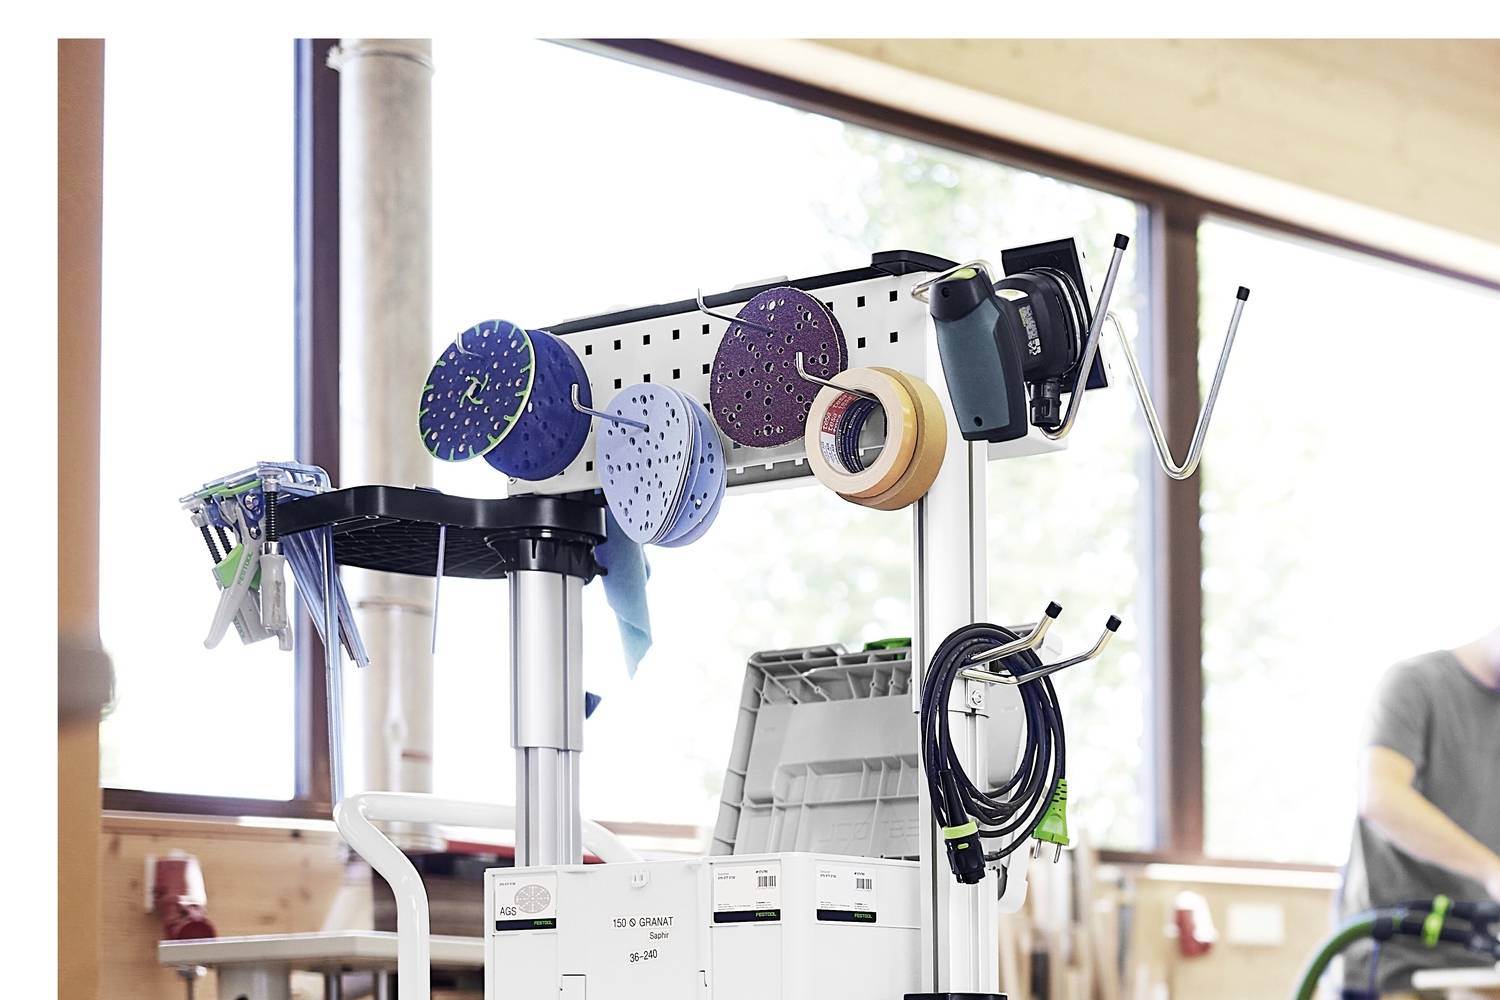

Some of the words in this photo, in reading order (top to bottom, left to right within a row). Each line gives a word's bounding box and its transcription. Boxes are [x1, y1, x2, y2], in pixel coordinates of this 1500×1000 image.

[499, 906, 517, 916] AGS
[613, 918, 627, 928] 150
[639, 916, 674, 927] GRANAT
[649, 931, 669, 940] Saphir
[629, 948, 658, 963] 36-240
